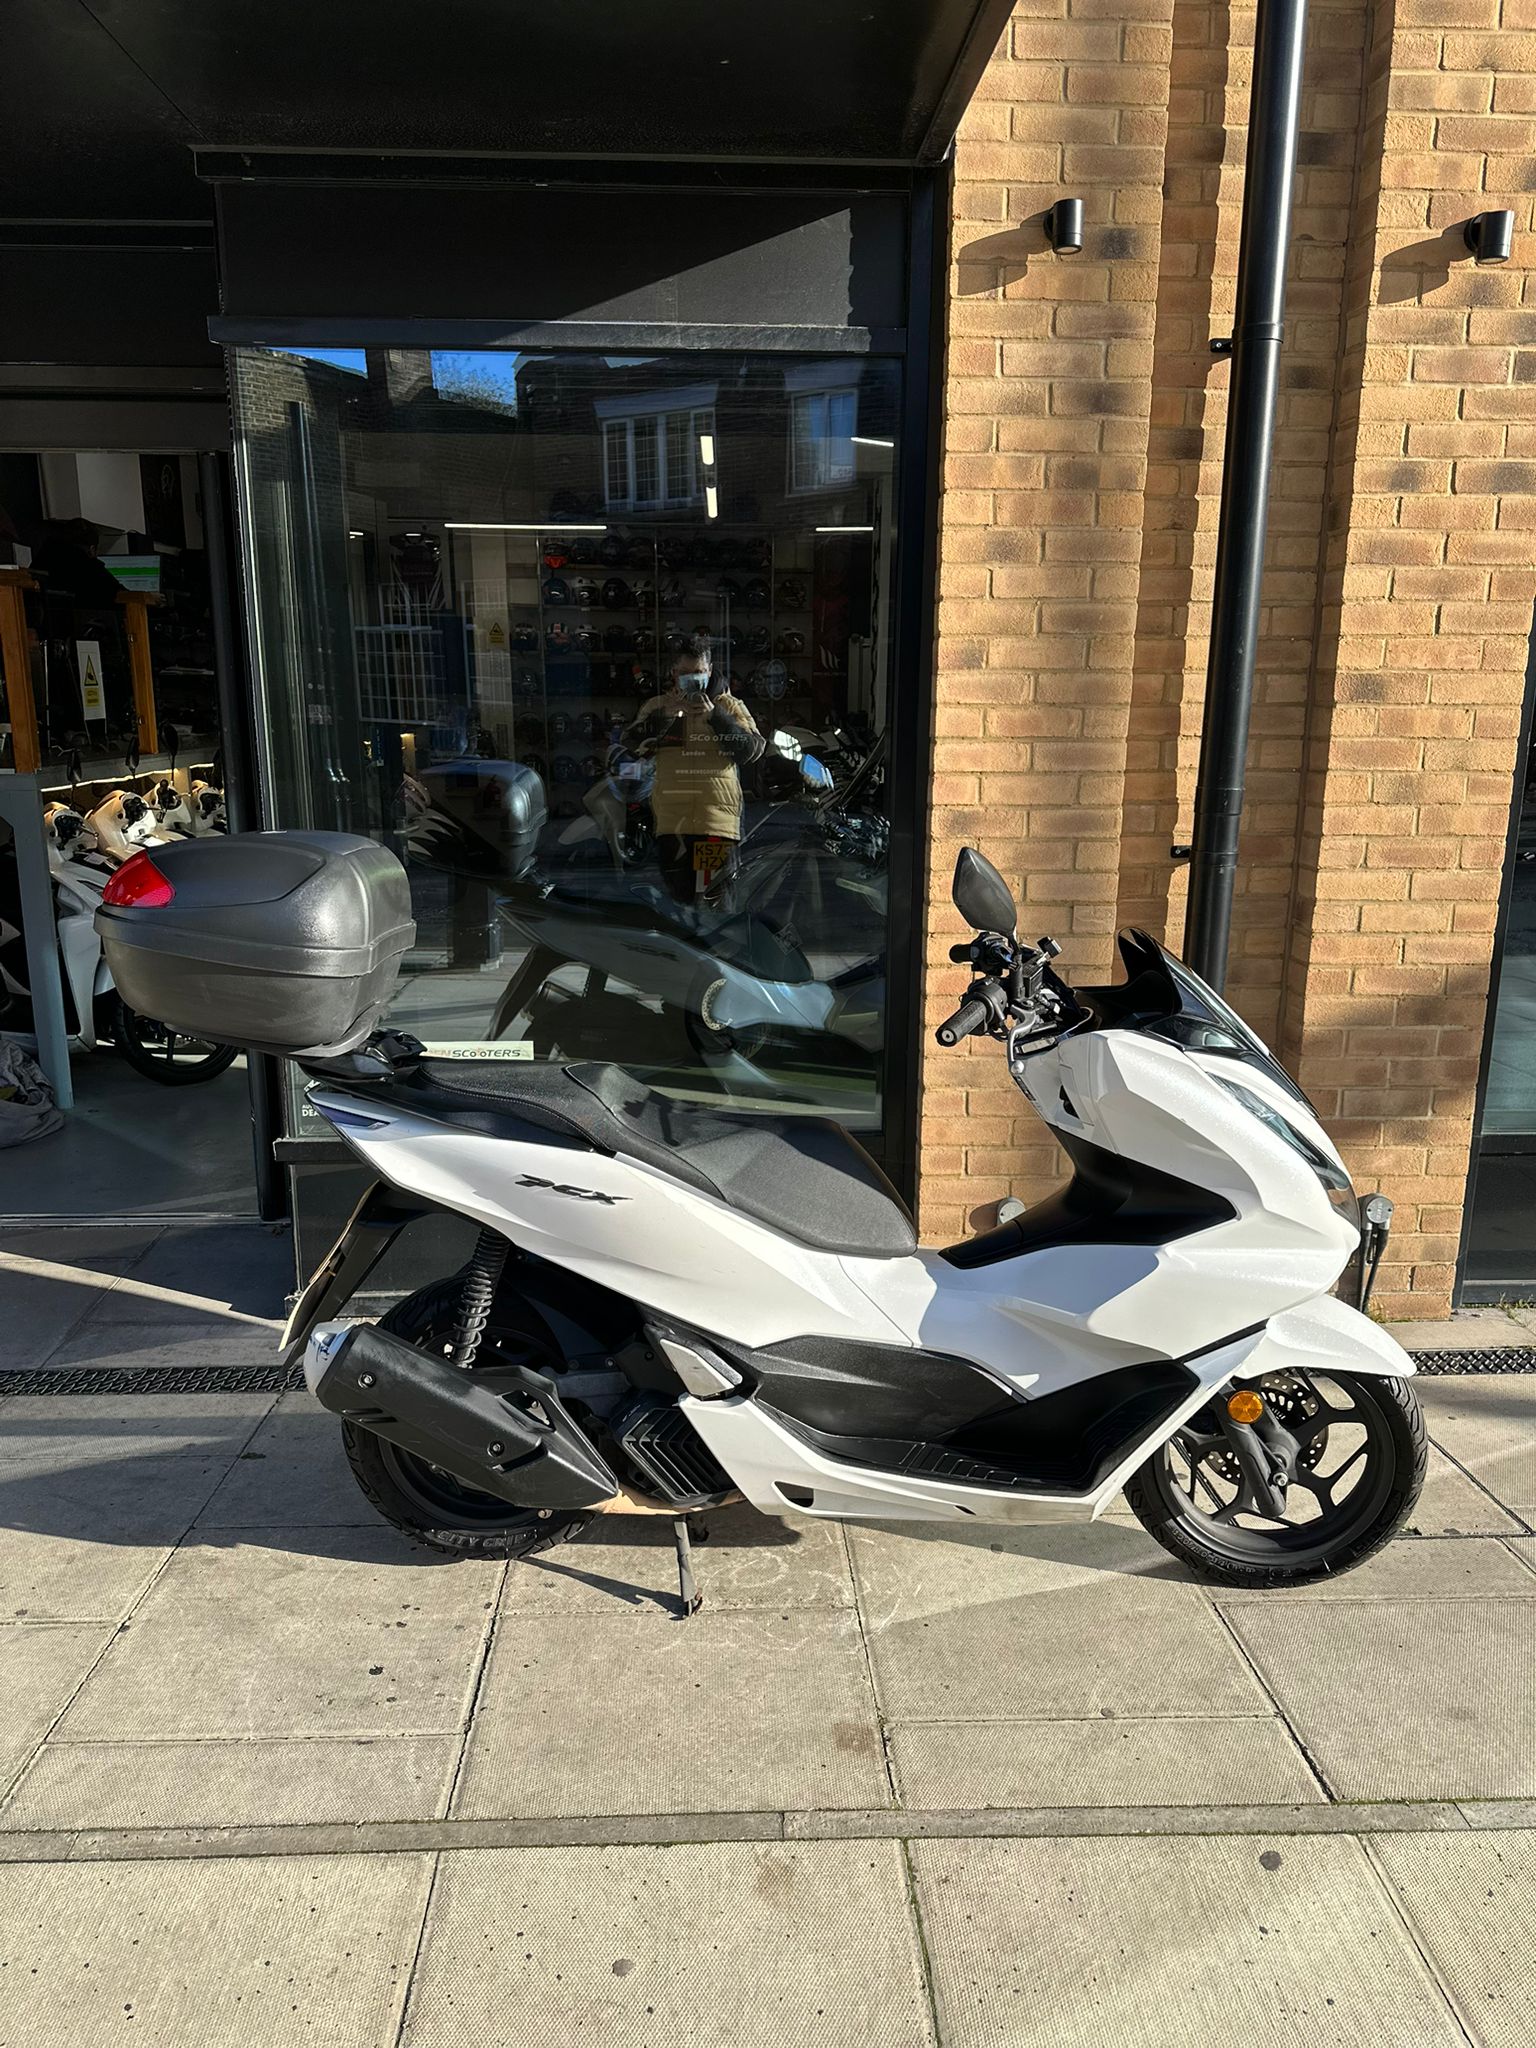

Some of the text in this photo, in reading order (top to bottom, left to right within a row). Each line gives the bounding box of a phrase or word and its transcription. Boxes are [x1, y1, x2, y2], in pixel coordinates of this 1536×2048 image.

[514, 1173, 633, 1205] PCX
[437, 1530, 480, 1547] CITY
[483, 1532, 525, 1547] GRIP
